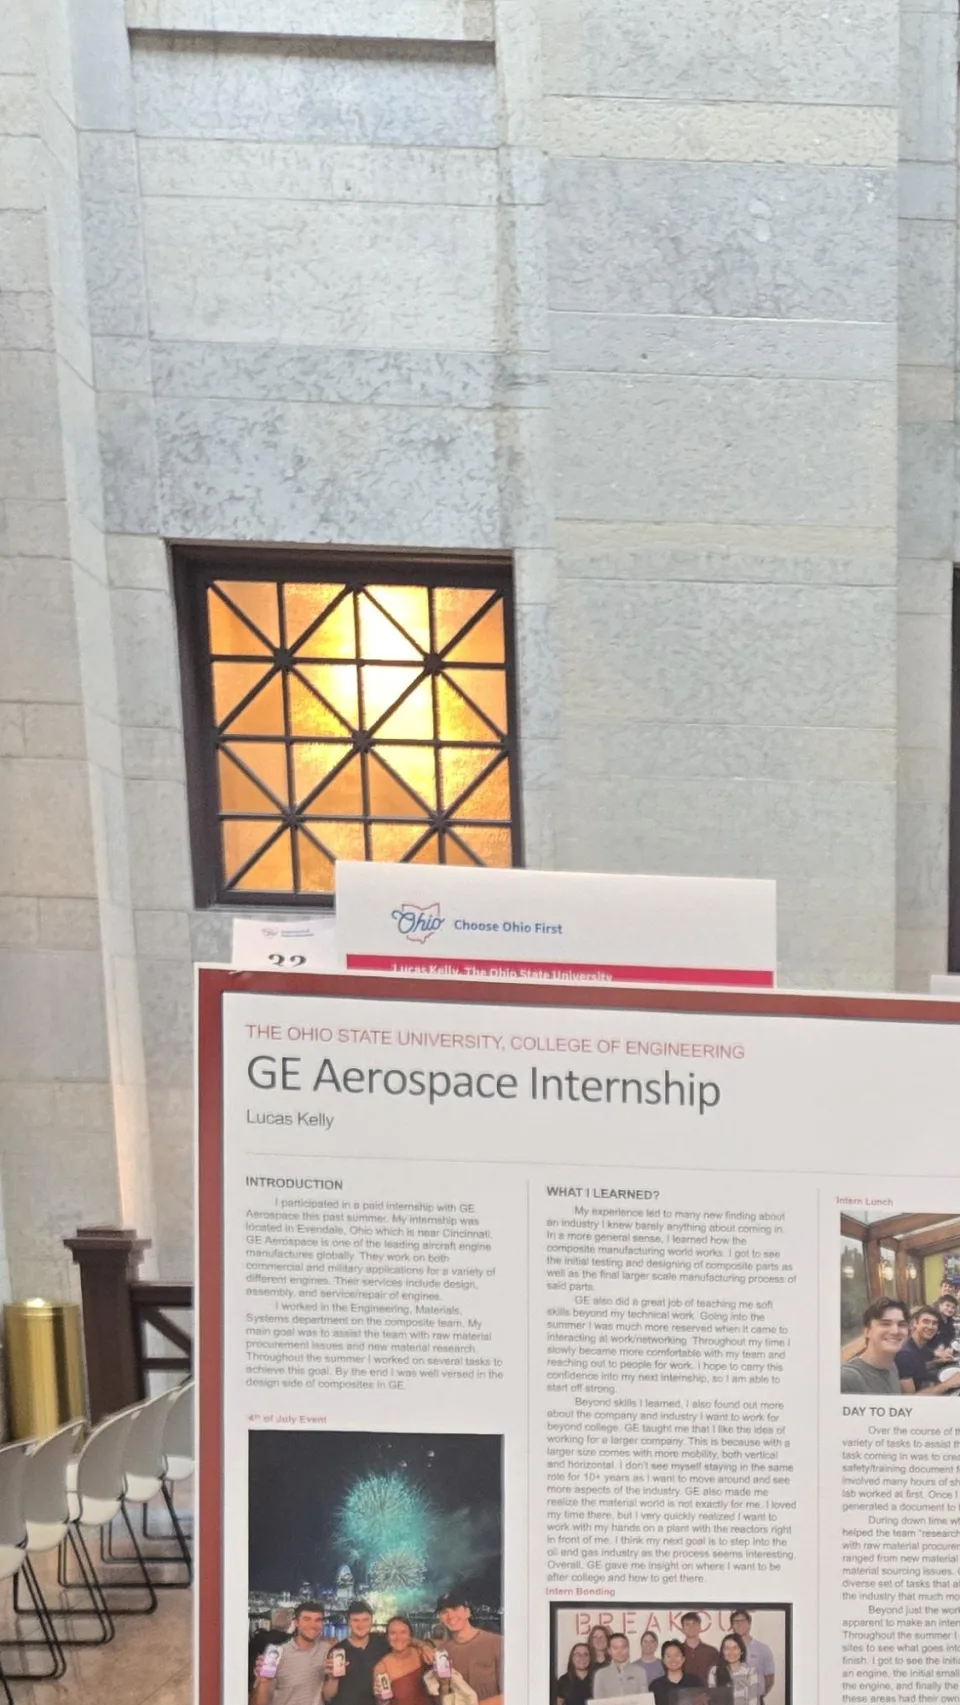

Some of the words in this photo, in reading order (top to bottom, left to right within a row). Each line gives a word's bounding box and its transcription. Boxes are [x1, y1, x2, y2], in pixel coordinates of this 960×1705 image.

[392, 910, 445, 934] Ohio
[454, 919, 499, 932] Choose
[503, 921, 531, 933] Ohio
[535, 923, 564, 935] First
[392, 964, 428, 974] Lucas
[464, 966, 486, 976] The
[490, 967, 516, 978] Ohio
[519, 968, 549, 980] State
[552, 970, 613, 982] University
[245, 1024, 281, 1040] THE
[287, 1026, 333, 1042] OHIO
[338, 1029, 392, 1045] STATE
[398, 1031, 506, 1051] UNIVERSITY,
[510, 1036, 591, 1054] COLLEGE
[597, 1039, 621, 1054] OF
[626, 1041, 745, 1059] ENGINEERING
[247, 1055, 302, 1091] GE
[313, 1058, 518, 1104] Aerospace
[530, 1066, 721, 1115] Internship
[246, 1109, 293, 1126] Lucas
[297, 1111, 335, 1130] Kelly
[245, 1176, 343, 1190] INTRODUCTION
[547, 1186, 583, 1198] WHAT
[586, 1188, 590, 1198] I
[594, 1188, 660, 1200] LEARNED?
[362, 1200, 383, 1213] paid
[436, 1202, 456, 1212] with
[836, 1196, 863, 1205] Intern
[866, 1197, 893, 1207] Lunch
[645, 1207, 660, 1217] led
[674, 1210, 700, 1221] many
[702, 1211, 722, 1219] new
[724, 1210, 756, 1222] finding
[758, 1211, 785, 1221] about
[842, 1406, 866, 1417] DAY
[870, 1407, 886, 1417] TO
[889, 1407, 913, 1418] DAY
[276, 1415, 296, 1424] July
[300, 1416, 327, 1424] Event
[547, 1447, 574, 1459] larger
[576, 1447, 596, 1457] size
[598, 1449, 630, 1457] comes
[632, 1448, 652, 1457] with
[654, 1450, 679, 1458] more
[680, 1448, 718, 1460] mobility,
[720, 1449, 742, 1458] both
[744, 1449, 778, 1459] vertical
[842, 1450, 861, 1460] task
[863, 1450, 897, 1462] coming
[909, 1453, 928, 1461] was
[573, 1486, 611, 1497] aspects
[624, 1485, 640, 1495] the
[642, 1485, 682, 1497] industry.
[702, 1486, 722, 1495] also
[724, 1486, 751, 1495] made
[842, 1540, 861, 1549] with
[863, 1542, 880, 1550] raw
[546, 1587, 573, 1596] Intern
[576, 1588, 616, 1598] Bonding
